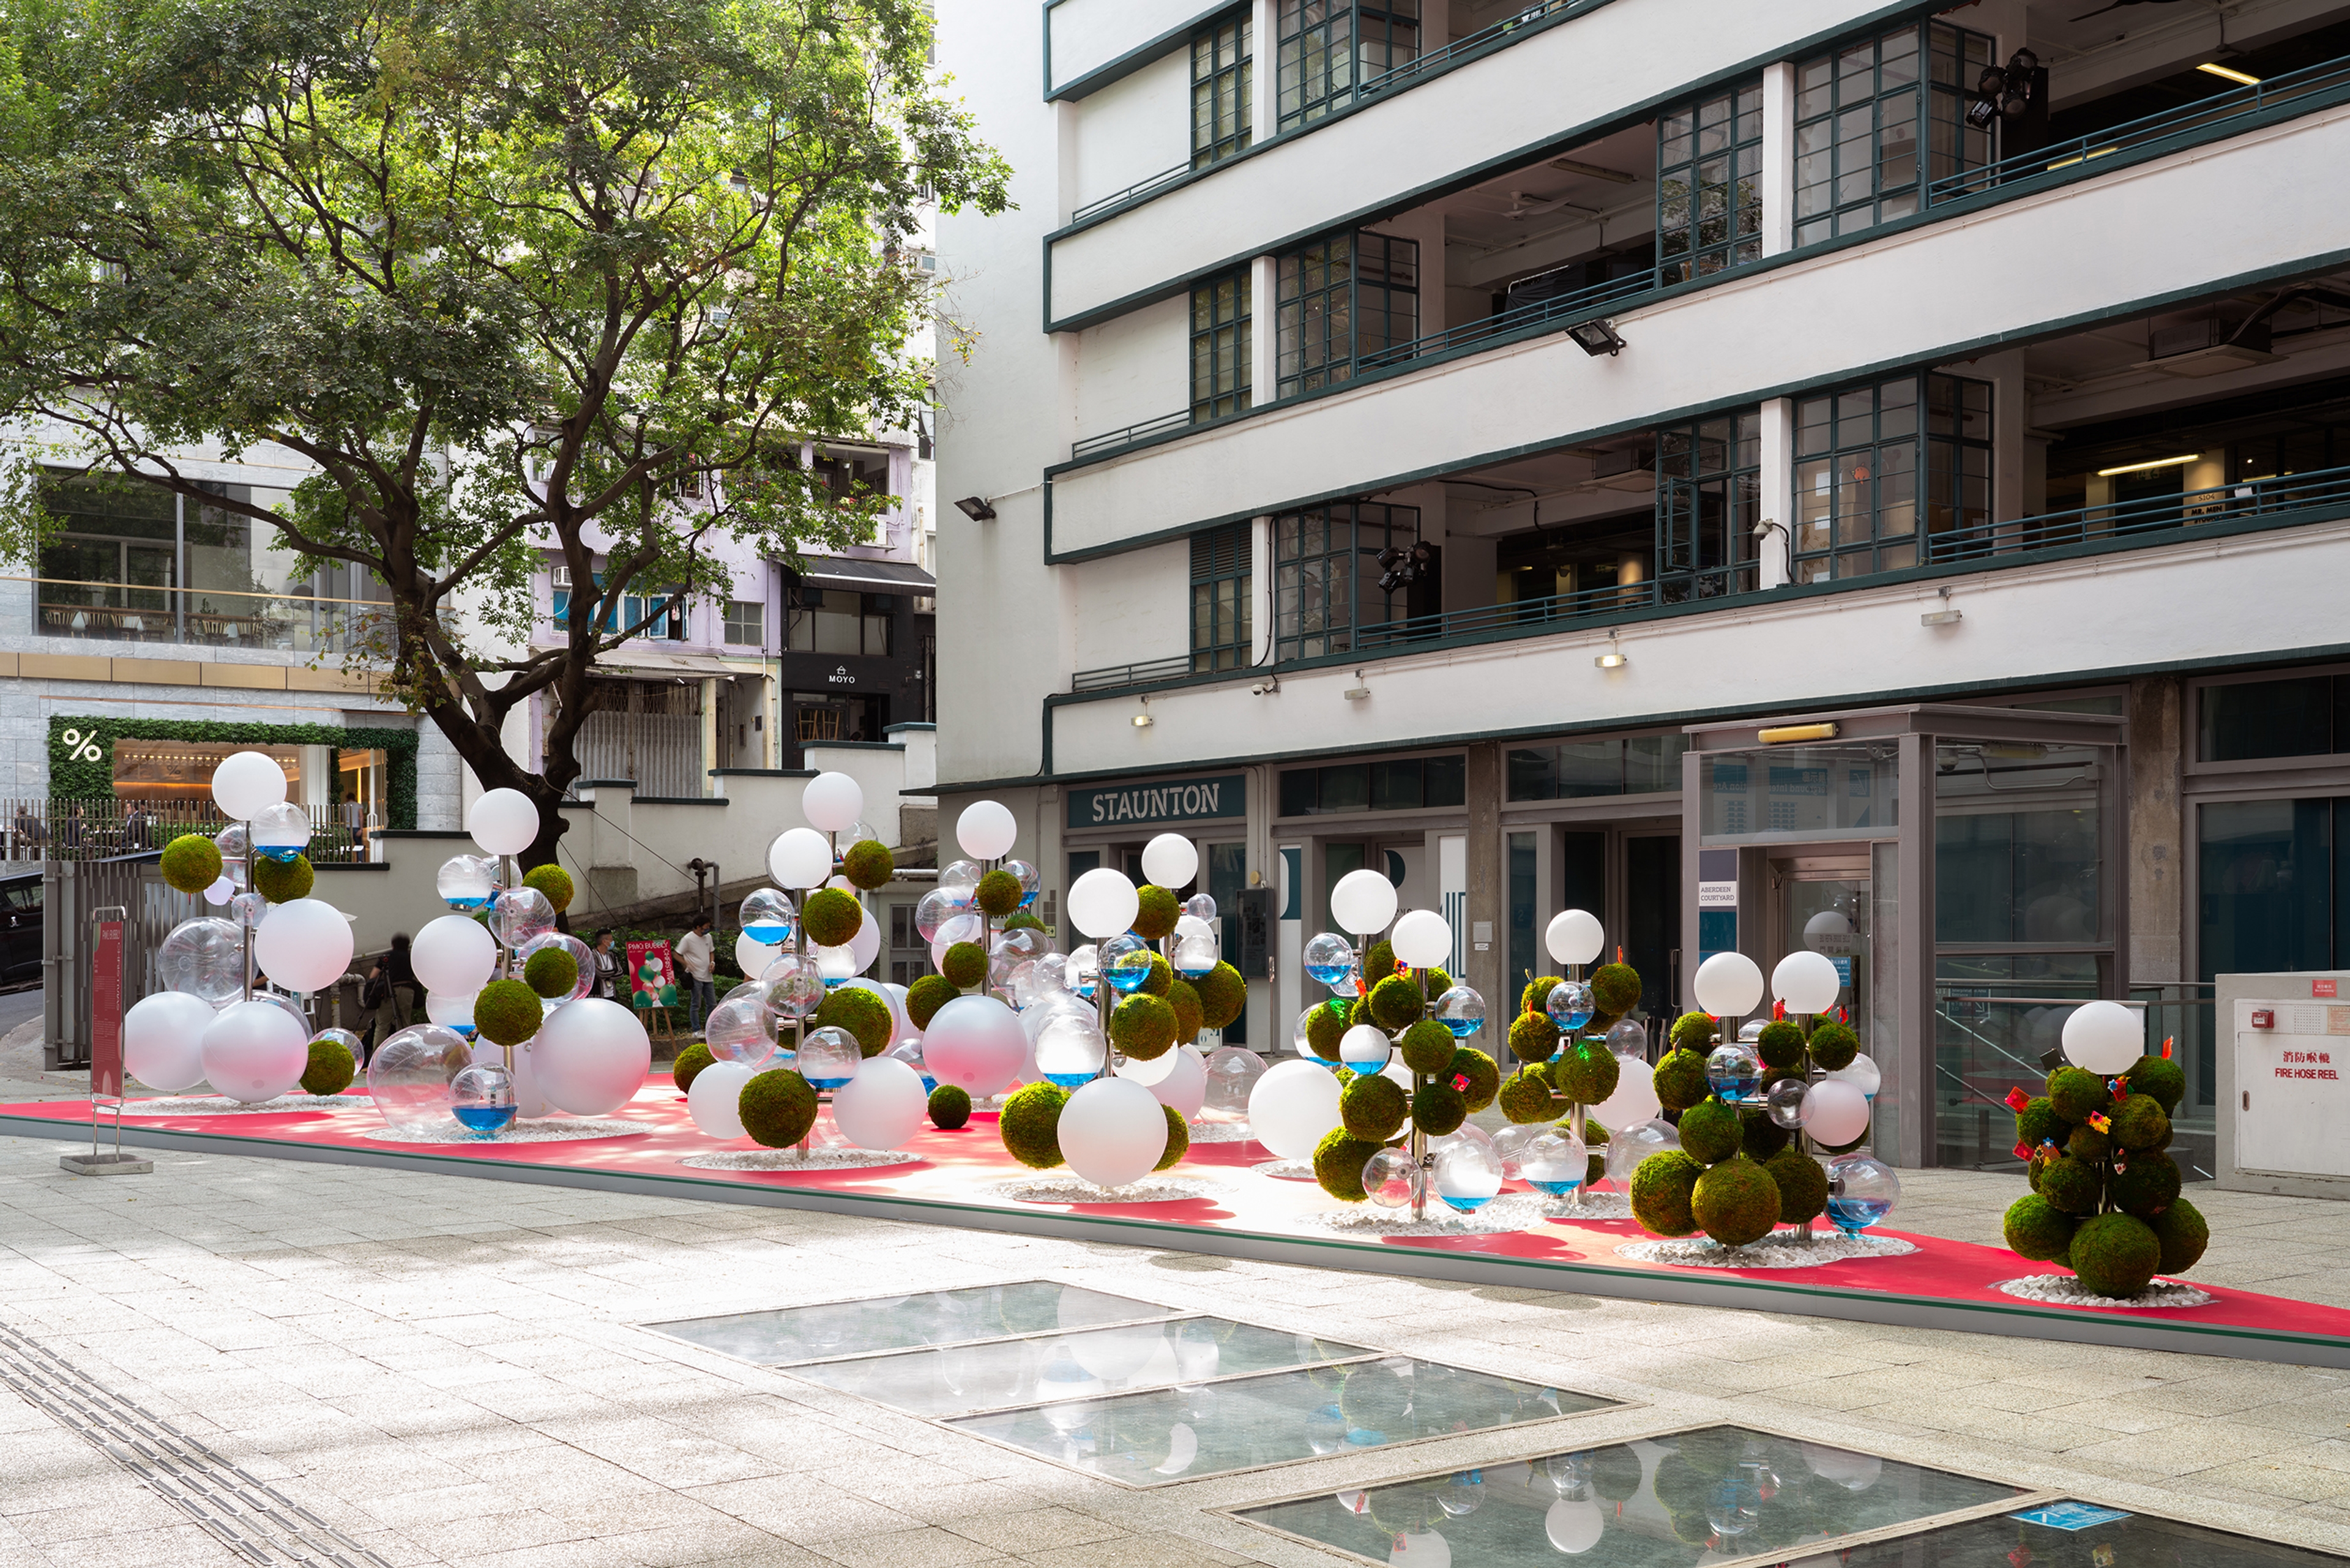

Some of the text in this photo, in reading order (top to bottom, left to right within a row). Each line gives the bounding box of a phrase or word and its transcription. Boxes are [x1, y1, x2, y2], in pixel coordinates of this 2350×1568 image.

[2206, 505, 2222, 514] MEN
[829, 675, 856, 684] MOYO
[1092, 783, 1220, 822] STAUNTON
[1518, 909, 1524, 922] 2
[663, 949, 674, 987] CHRISTMAS
[2275, 1068, 2339, 1080] FIRE HOSE REEL
